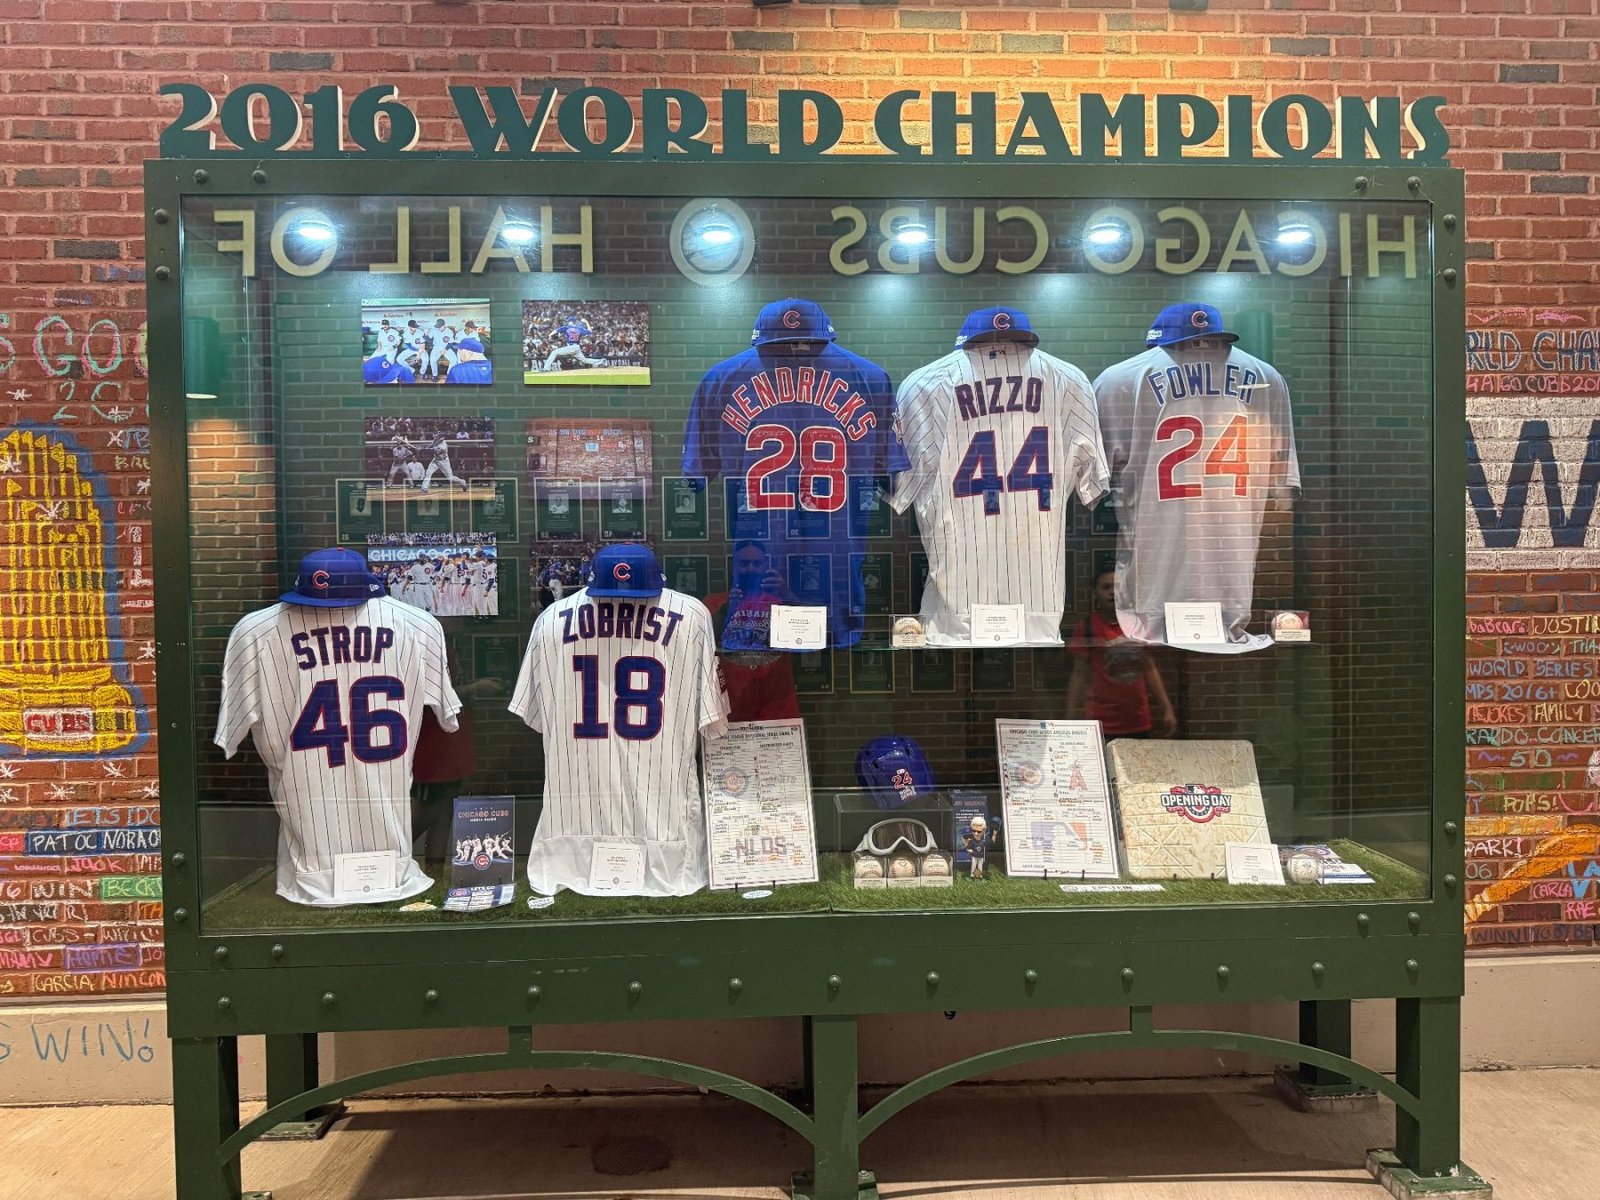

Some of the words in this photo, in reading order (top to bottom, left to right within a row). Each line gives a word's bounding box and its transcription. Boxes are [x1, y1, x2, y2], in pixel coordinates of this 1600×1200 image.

[160, 84, 420, 155] 2016
[450, 85, 843, 157] WORLD
[874, 90, 1449, 163] CHAMPIONS
[1532, 330, 1600, 371] CHA
[721, 366, 877, 441] HENDRICKS
[954, 375, 1042, 421] RIZZO
[1147, 362, 1257, 406] FOWLER
[1572, 375, 1600, 393] 201
[745, 424, 847, 512] 28
[952, 426, 1053, 516] 44
[1155, 413, 1250, 501] 24
[312, 570, 330, 590] C
[613, 562, 631, 581] C
[559, 602, 684, 646] ZOBRIST
[290, 625, 394, 671] STROP
[1469, 659, 1526, 676] WORLD
[1534, 660, 1594, 677] SERIES
[572, 654, 666, 740] 18
[1534, 702, 1584, 722] FAMILY
[27, 714, 88, 733] CUBS
[290, 675, 408, 768] 46
[891, 771, 913, 790] 24
[1161, 794, 1210, 807] OPENING
[1211, 795, 1231, 807] DAY
[735, 835, 787, 860] NLDS
[31, 1017, 154, 1063] WIN!
